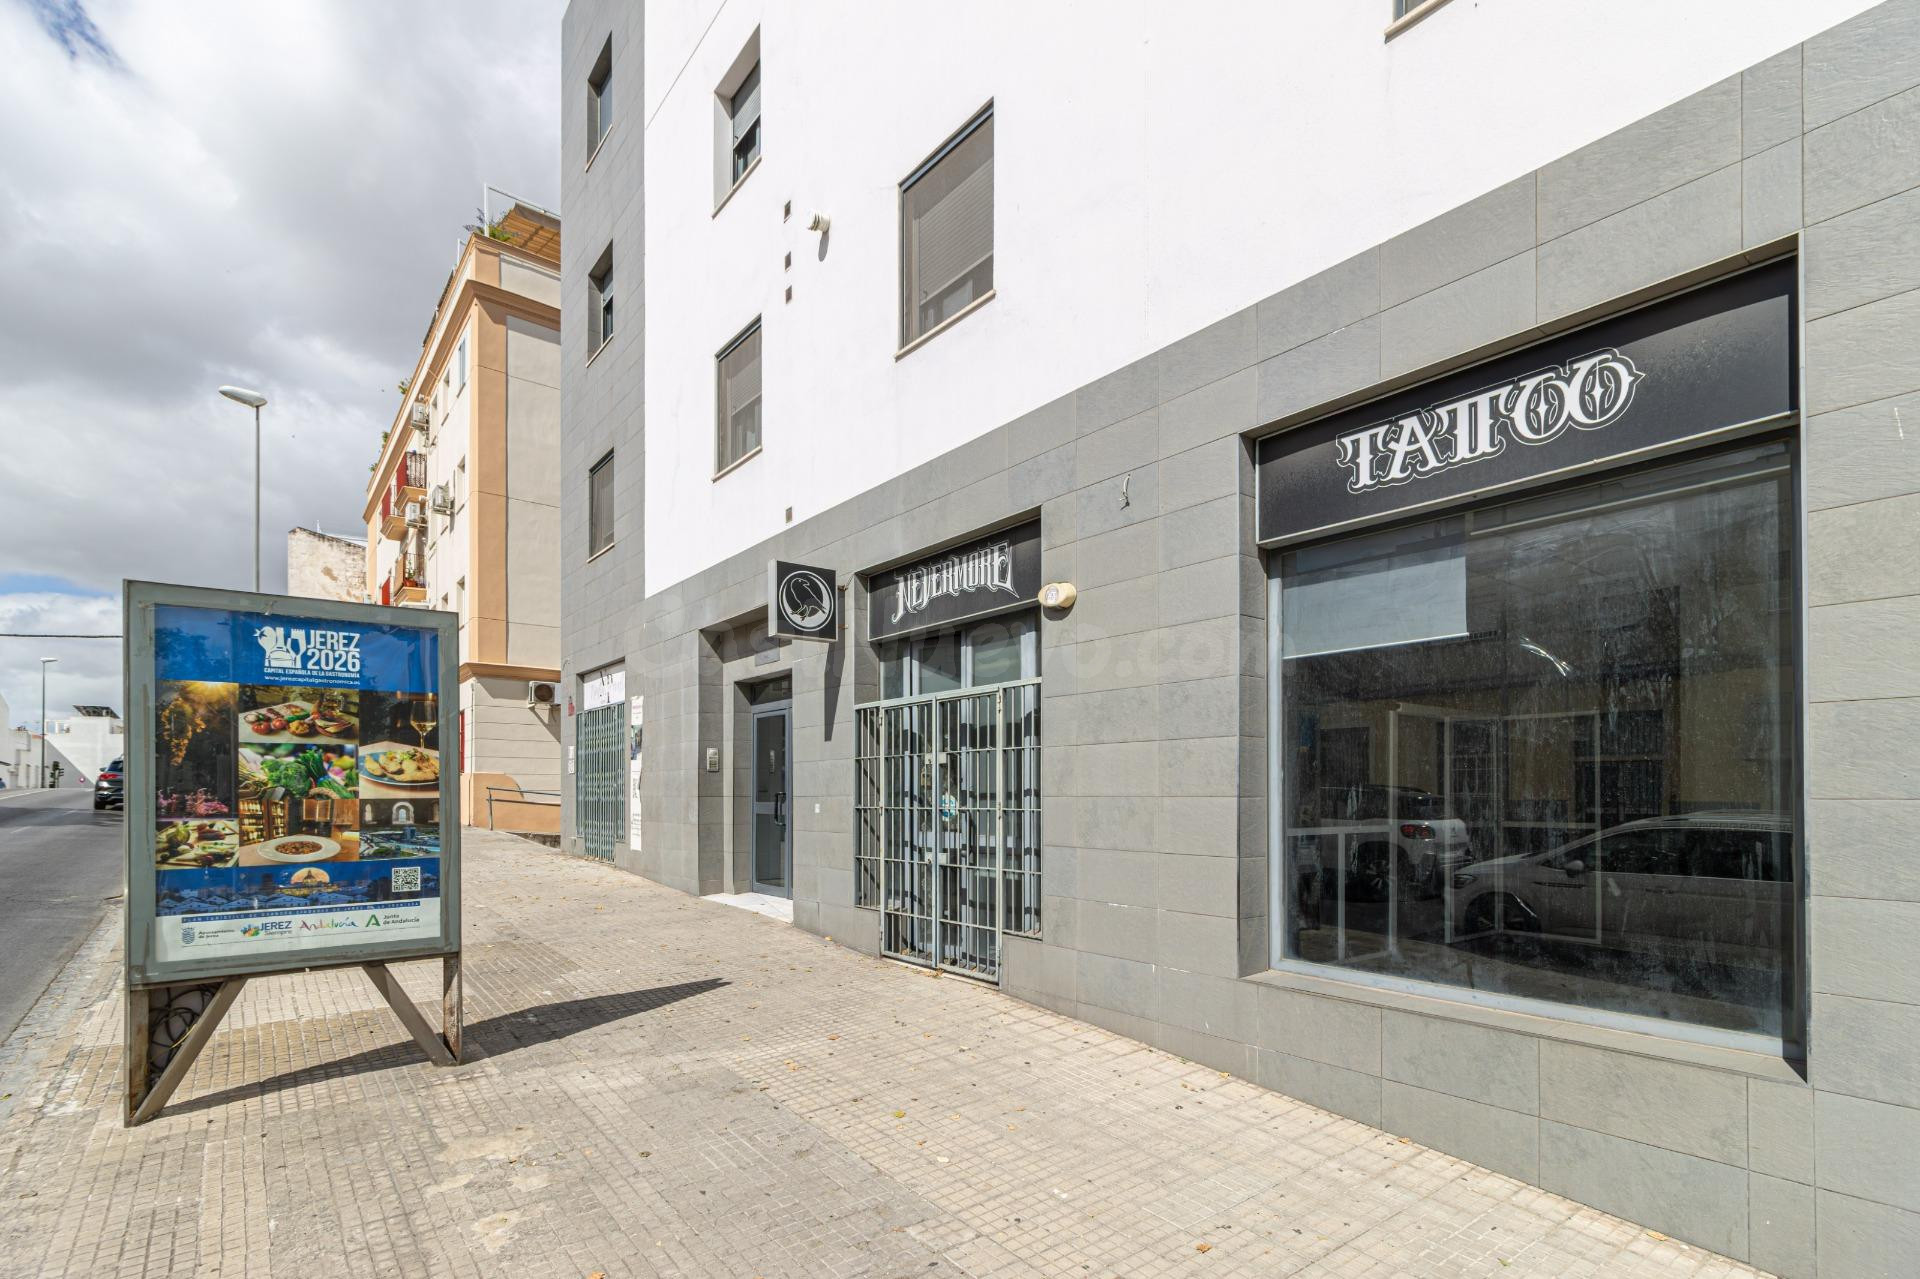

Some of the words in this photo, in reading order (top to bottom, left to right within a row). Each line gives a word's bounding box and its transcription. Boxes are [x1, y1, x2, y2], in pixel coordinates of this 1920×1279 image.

[1336, 348, 1645, 494] TATTOO
[892, 541, 1020, 624] NEVERMORE
[306, 629, 360, 652] JEREZ
[306, 648, 360, 672] 2026
[260, 920, 292, 931] JEREZ
